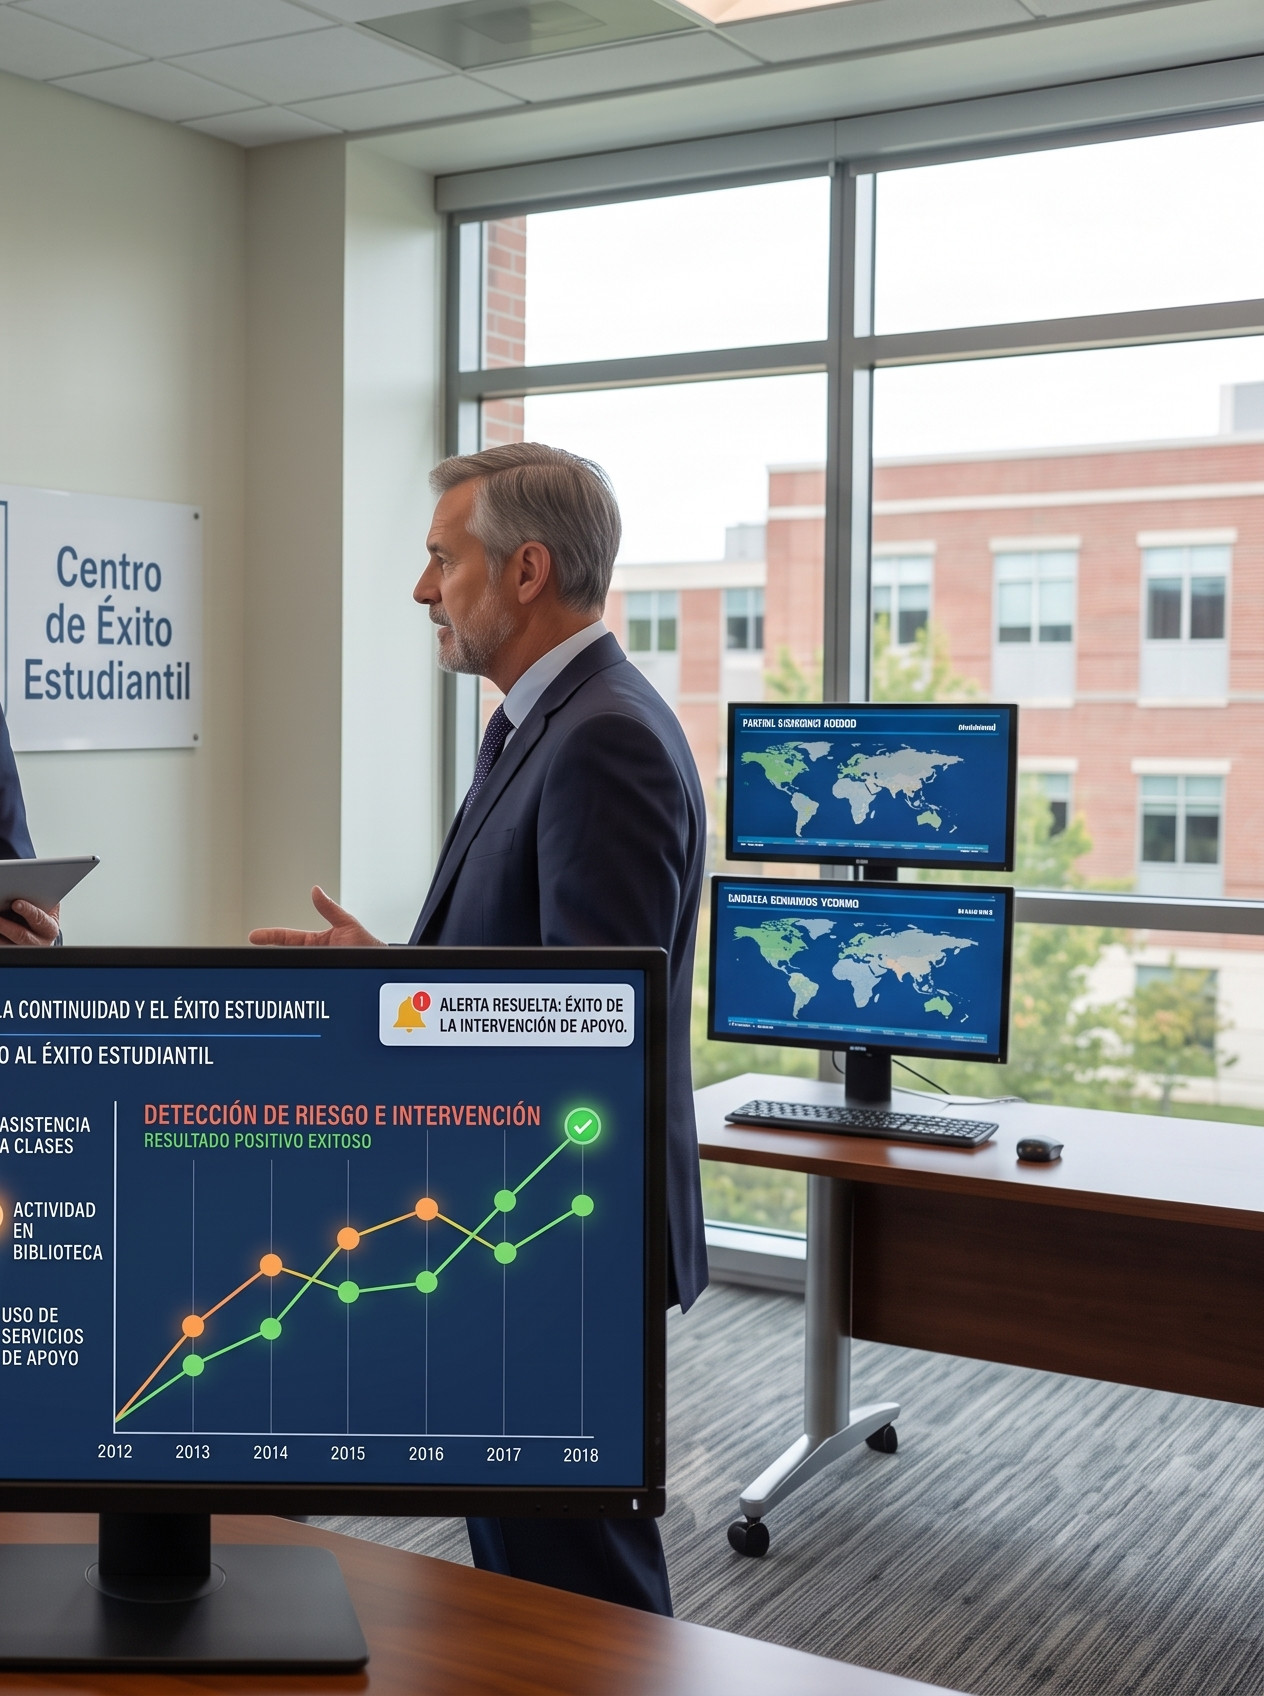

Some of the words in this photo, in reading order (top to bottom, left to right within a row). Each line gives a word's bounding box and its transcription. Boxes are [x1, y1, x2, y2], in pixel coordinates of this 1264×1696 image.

[56, 545, 162, 592] Centro
[45, 602, 86, 645] de
[97, 594, 173, 646] Éxito
[24, 658, 191, 701] Estudiantil
[18, 999, 131, 1020] CONTINUIDAD
[134, 1000, 146, 1019] Y
[150, 1000, 169, 1019] EL
[174, 995, 220, 1020] ÉXITO
[225, 1000, 330, 1020] ESTUDIANTIL
[439, 997, 490, 1012] ALERTA
[492, 997, 562, 1013] RESUELTA:
[565, 994, 603, 1013] ÉXITO
[606, 998, 624, 1013] DE
[440, 1018, 457, 1033] LA
[460, 1015, 556, 1033] INTERVENCIÓN
[560, 1018, 578, 1033] DE
[580, 1018, 627, 1034] APOYO.
[14, 1045, 37, 1065] AL
[42, 1041, 93, 1065] ÉXITO
[98, 1045, 214, 1065] ESTUDIANTIL
[143, 1099, 258, 1126] DETECCIÓN
[263, 1103, 289, 1126] DE
[295, 1104, 369, 1126] RIESGO
[374, 1104, 387, 1126] E
[392, 1100, 541, 1127] INTERVENCIÓN
[0, 1116, 91, 1133] ASISTENCIA
[0, 1137, 10, 1154] A
[14, 1137, 74, 1154] CLASES
[143, 1131, 231, 1149] RESULTADO
[233, 1132, 304, 1150] POSITIVO
[307, 1132, 373, 1150] EXITOSO
[13, 1201, 96, 1218] ACTIVIDAD
[13, 1222, 33, 1239] EN
[13, 1243, 103, 1261] BIBLIOTECA
[2, 1306, 33, 1323] USO
[38, 1307, 59, 1323] DE
[1, 1327, 84, 1345] SERVICIOS
[2, 1349, 22, 1366] DE
[26, 1349, 79, 1366] APOYO
[97, 1443, 133, 1459] 2012
[175, 1444, 210, 1459] 2013
[253, 1445, 289, 1460] 2014
[330, 1445, 366, 1461] 2015
[409, 1446, 444, 1461] 2016
[486, 1447, 522, 1462] 2017
[563, 1447, 599, 1463] 2018
